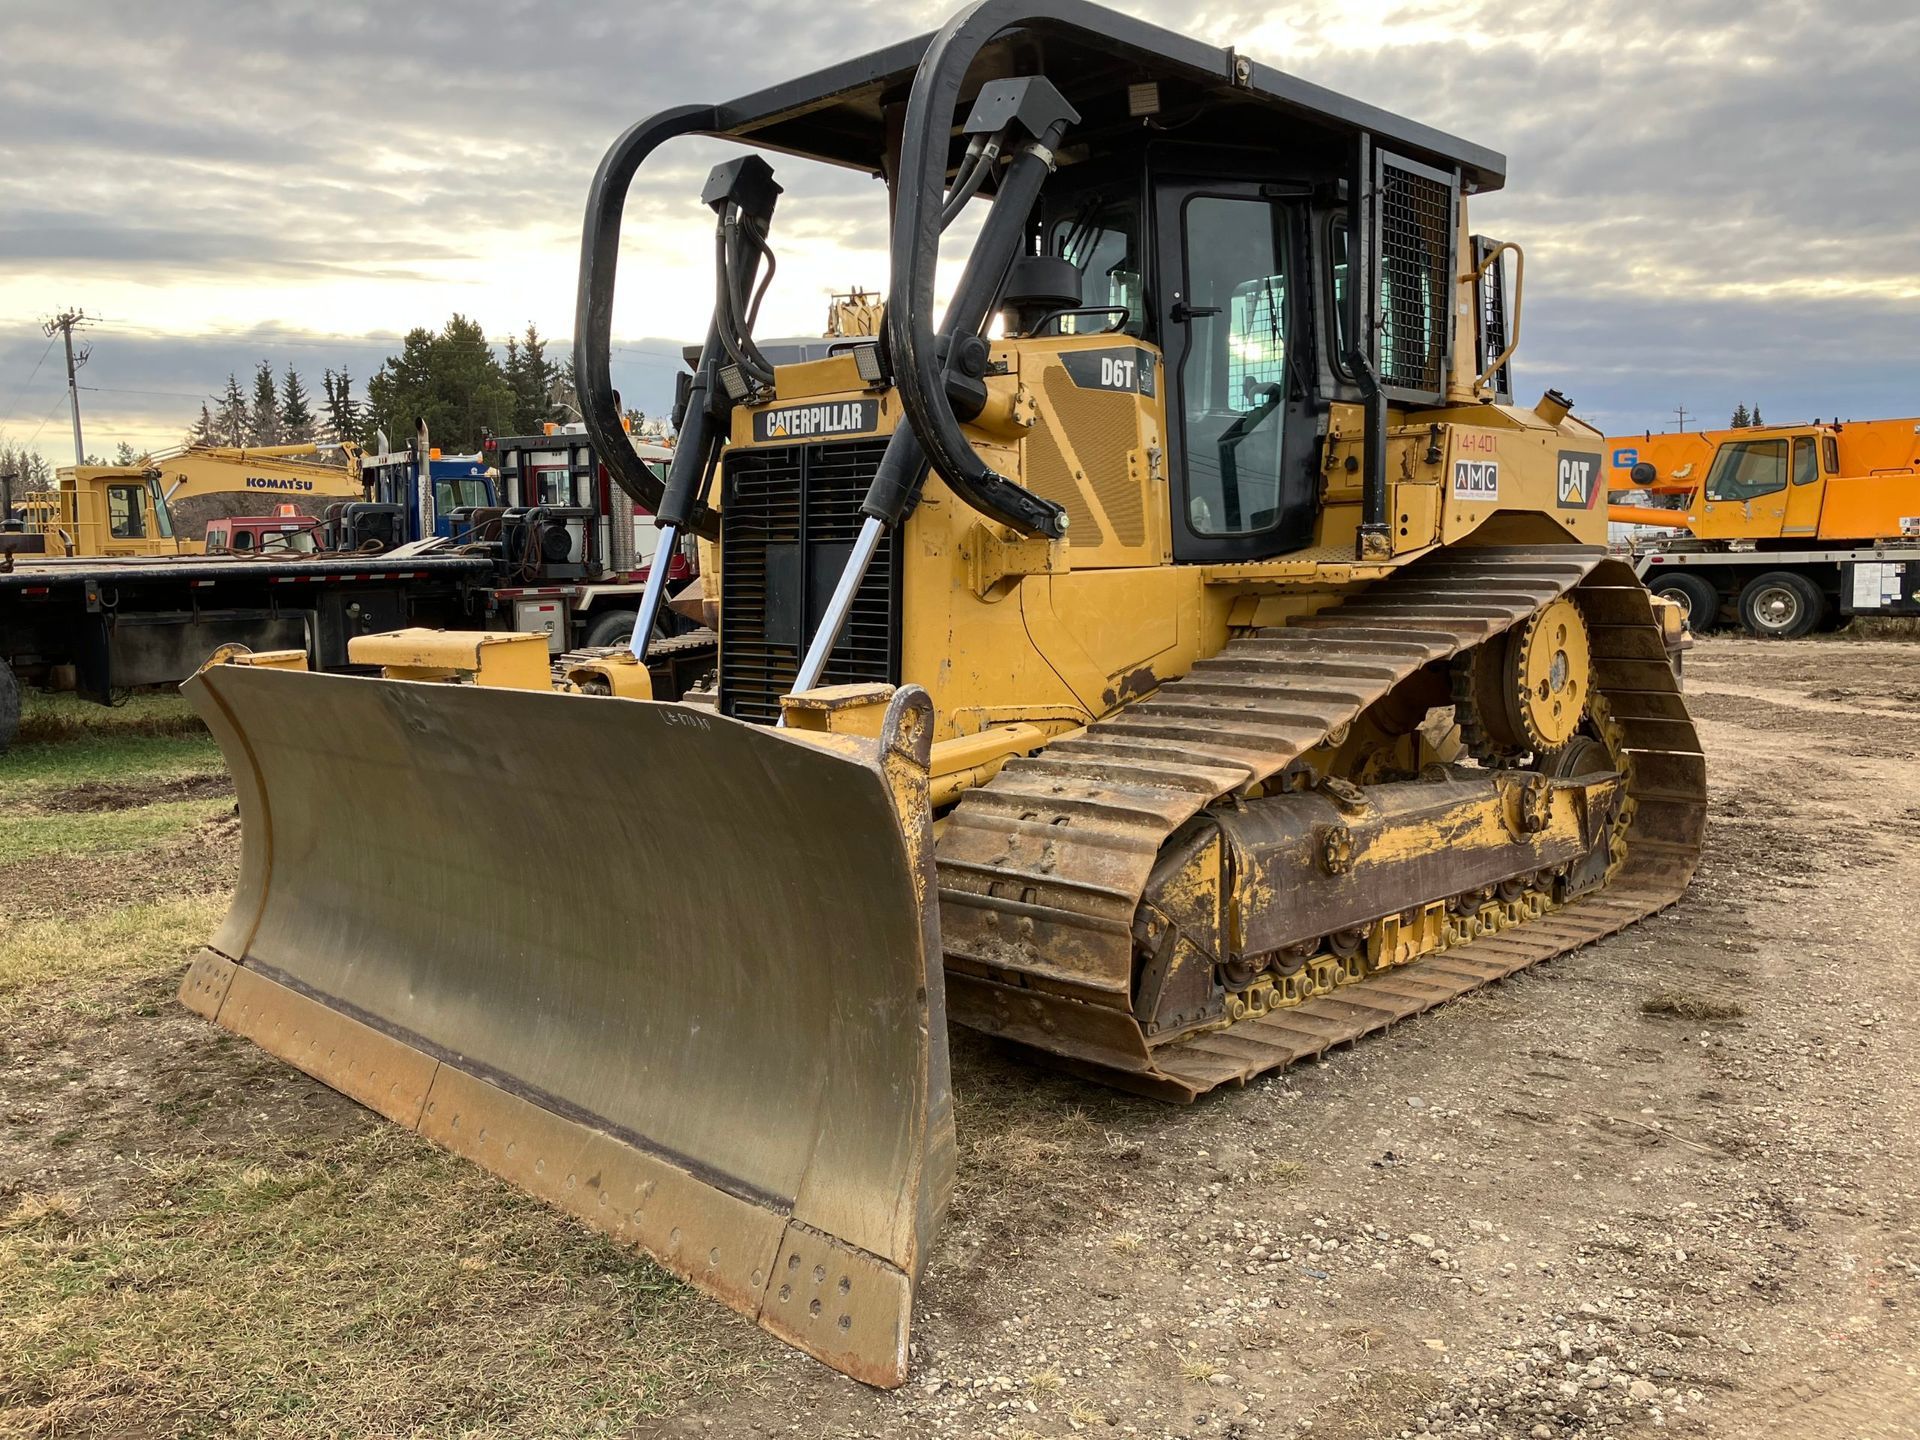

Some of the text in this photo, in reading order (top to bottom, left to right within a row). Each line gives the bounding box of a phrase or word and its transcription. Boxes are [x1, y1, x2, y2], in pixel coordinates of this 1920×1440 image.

[1101, 357, 1134, 388] D6T
[766, 403, 862, 437] CATERPILLAR
[1456, 433, 1497, 452] 14-1401
[246, 478, 313, 490] KOMATSU
[1456, 464, 1496, 490] AMC
[1559, 459, 1590, 504] CAT
